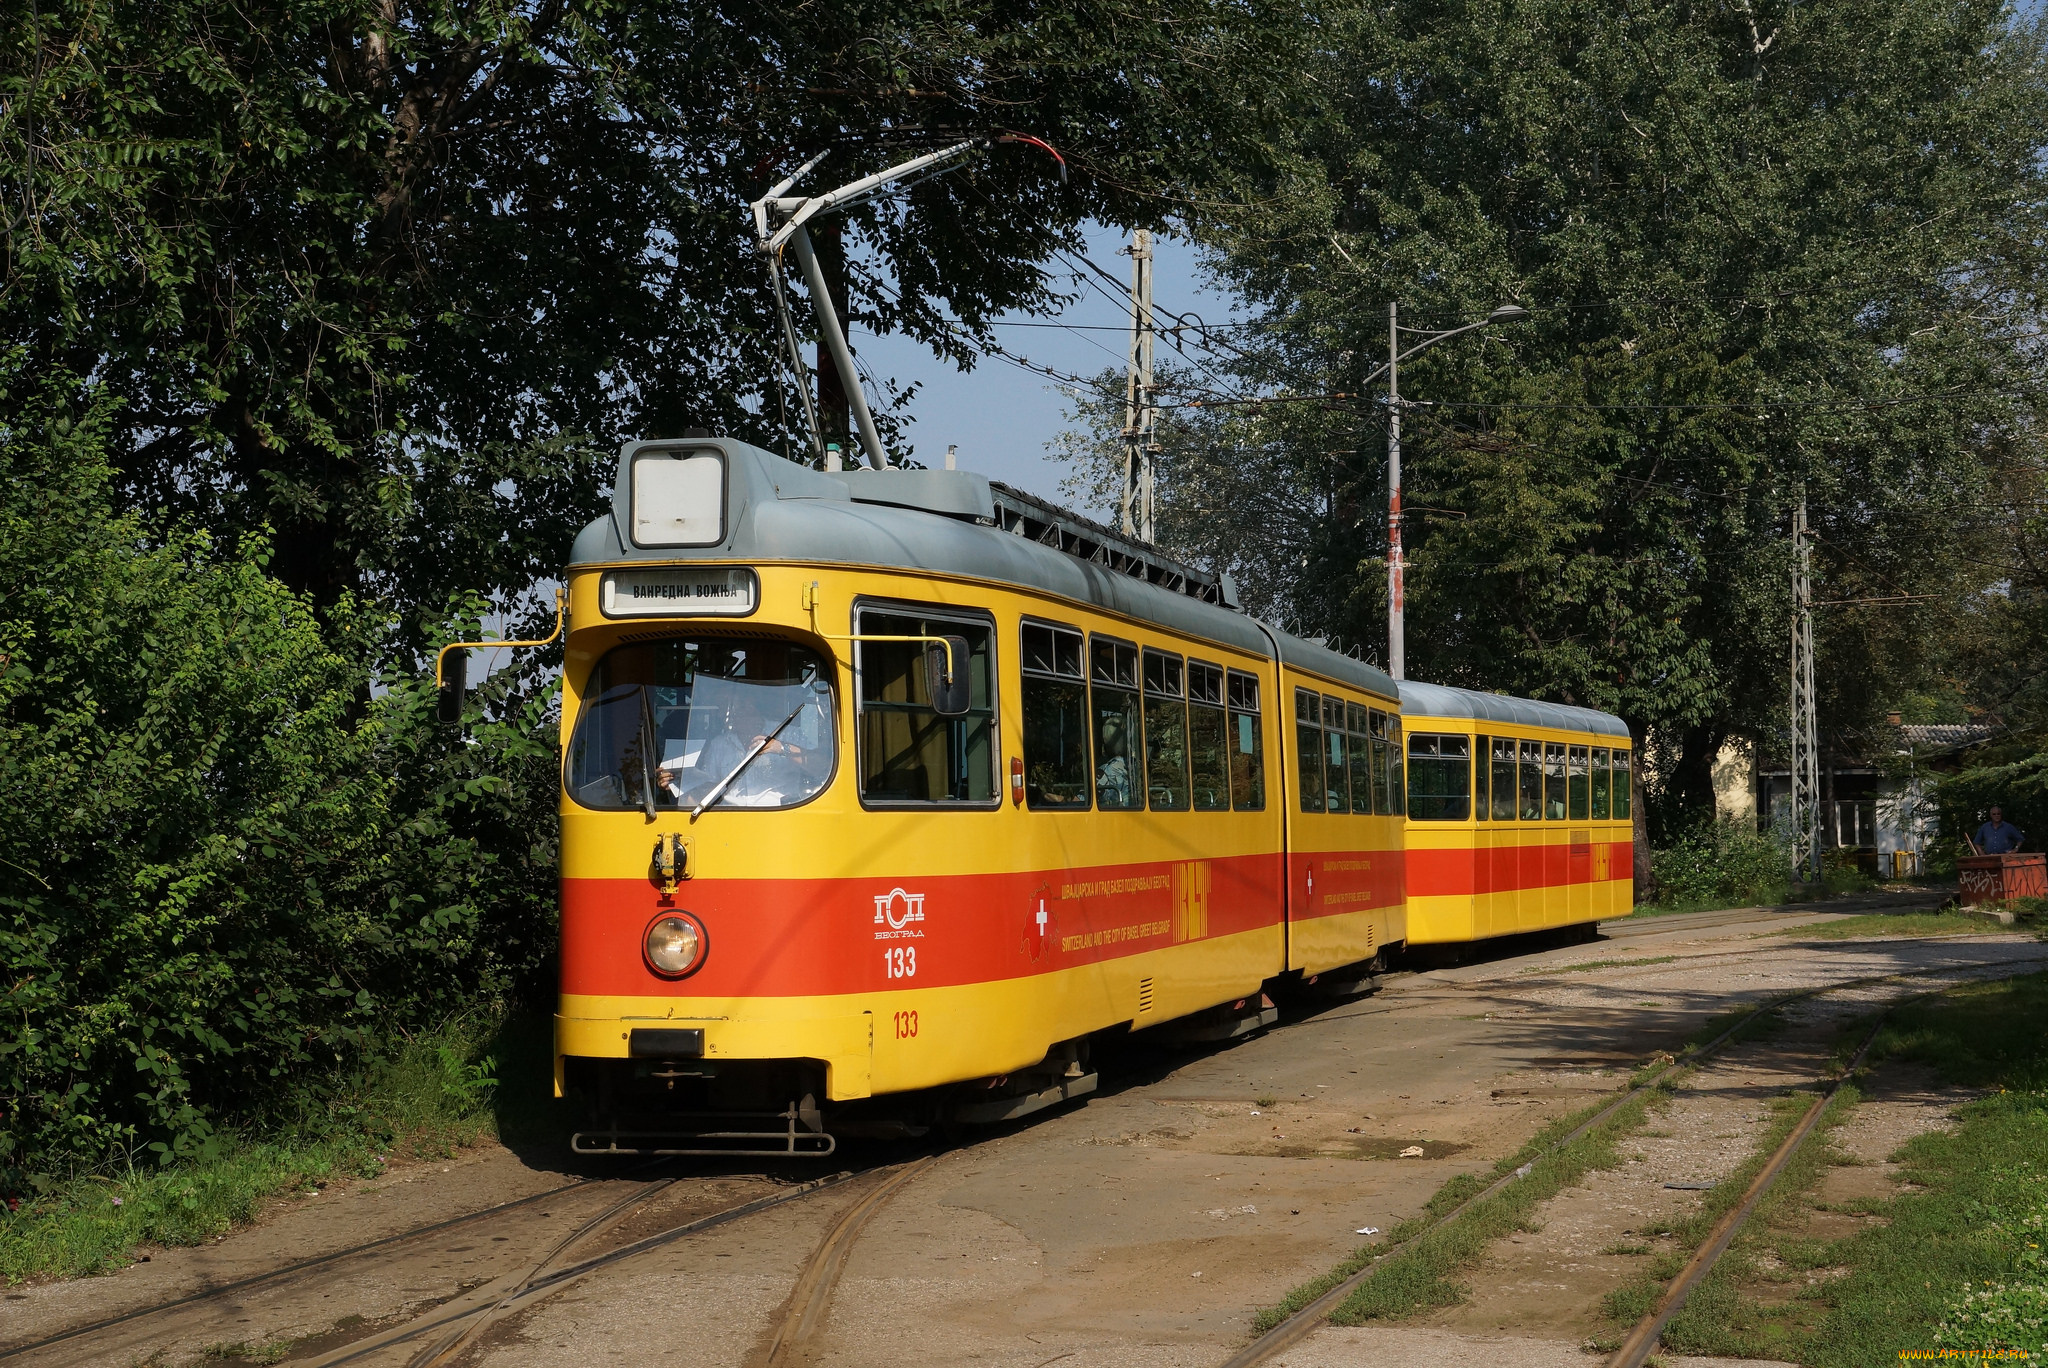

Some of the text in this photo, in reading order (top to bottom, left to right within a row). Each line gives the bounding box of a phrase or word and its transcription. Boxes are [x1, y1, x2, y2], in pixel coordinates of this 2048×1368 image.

[633, 584, 737, 600] ВАНРЕДНА ВОЖЊА
[1061, 933, 1093, 952] SWITZERLAND
[1093, 931, 1103, 947] AND
[1102, 929, 1111, 945] THE
[1111, 928, 1120, 943] CITY
[1120, 927, 1126, 941] OF
[1126, 925, 1139, 940] BASEL
[884, 946, 916, 979] 133
[893, 1010, 918, 1039] 133
